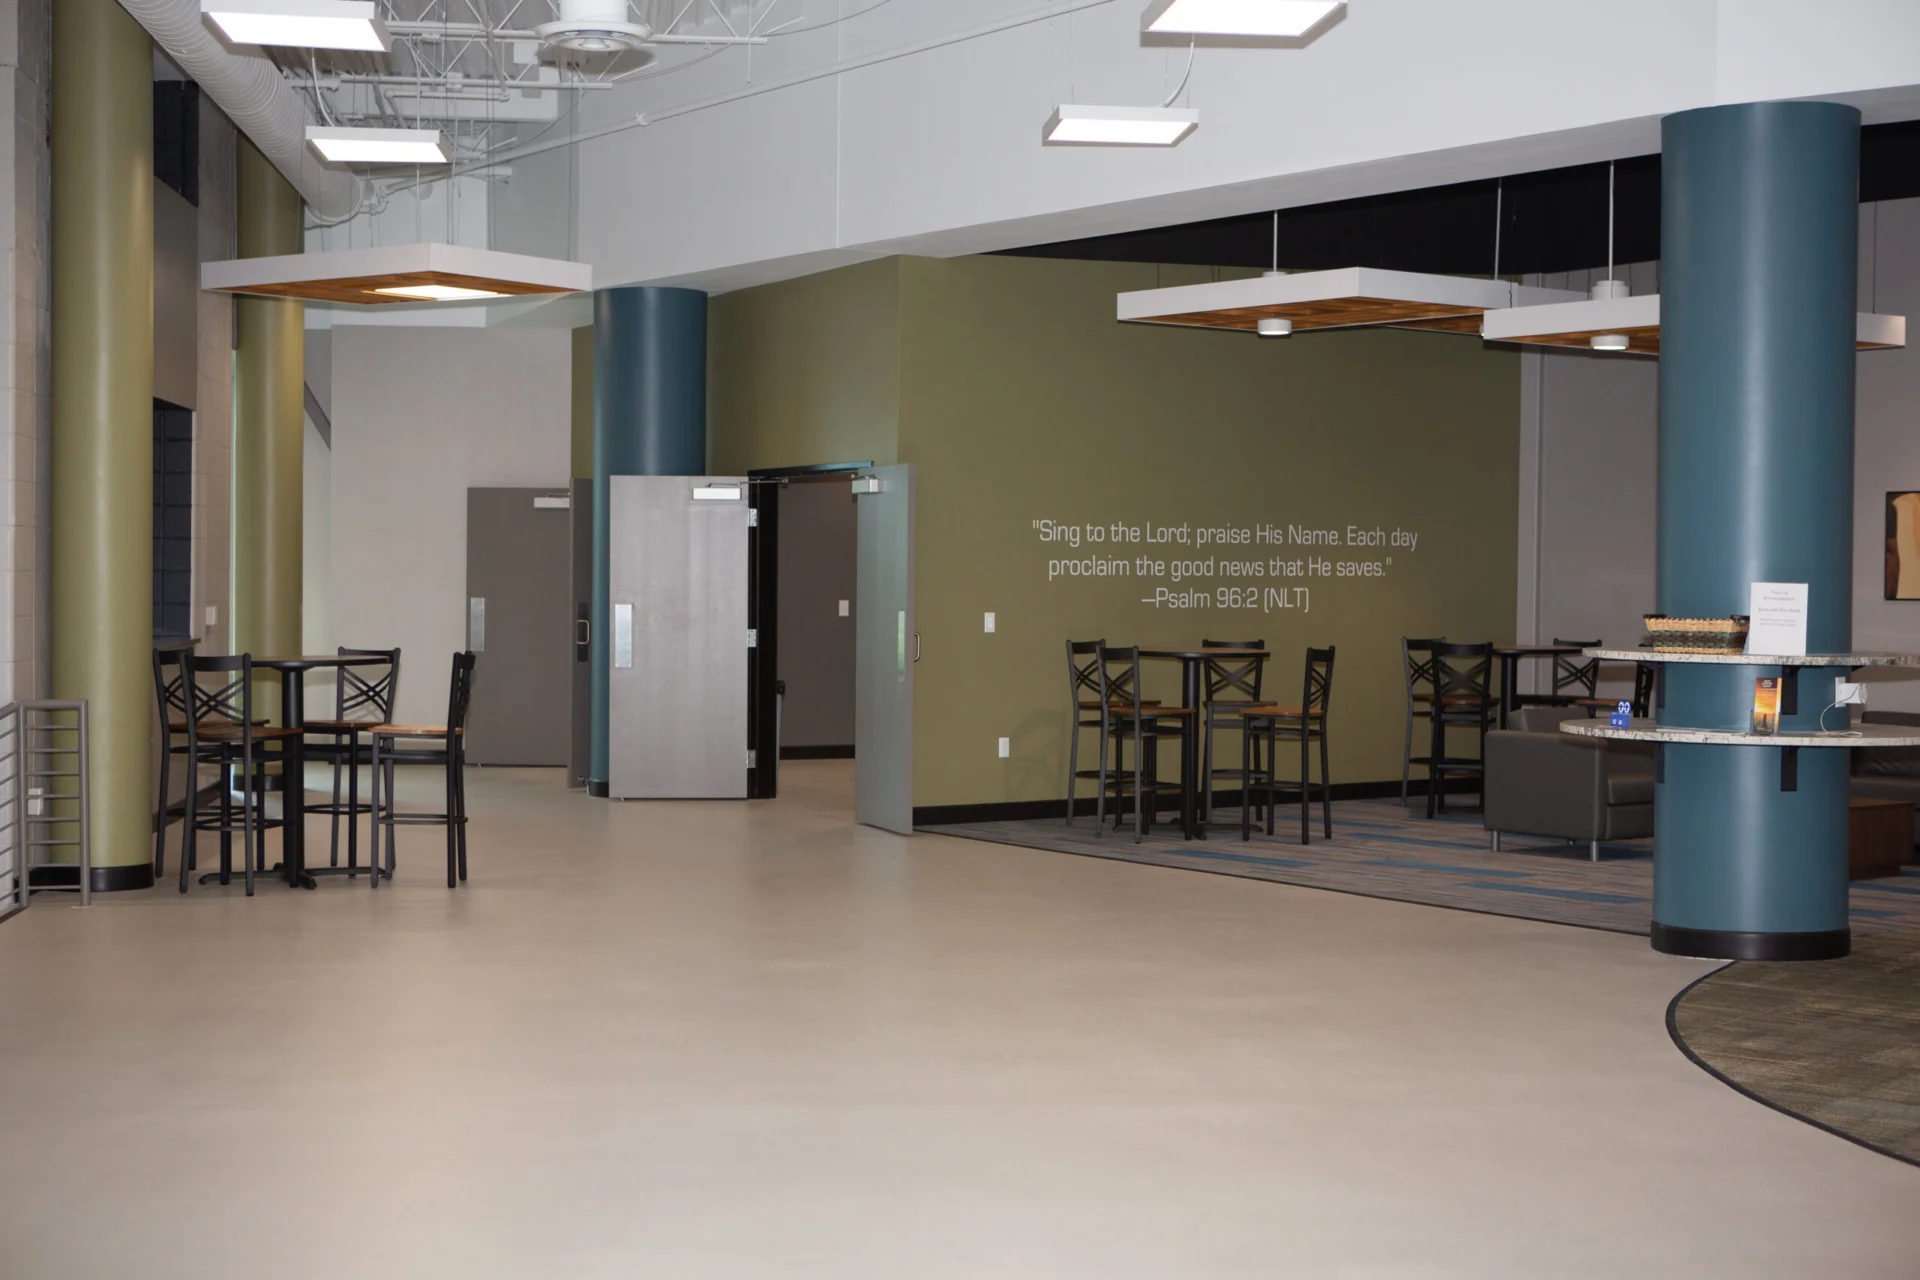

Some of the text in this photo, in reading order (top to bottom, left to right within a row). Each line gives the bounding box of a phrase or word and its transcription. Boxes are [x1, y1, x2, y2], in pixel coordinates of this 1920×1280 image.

[1032, 519, 1418, 552] "Sing to the Lord; praise His Name. Each day
[1048, 554, 1392, 582] proclaim the good news that He saves."
[1216, 587, 1258, 609] 96:2
